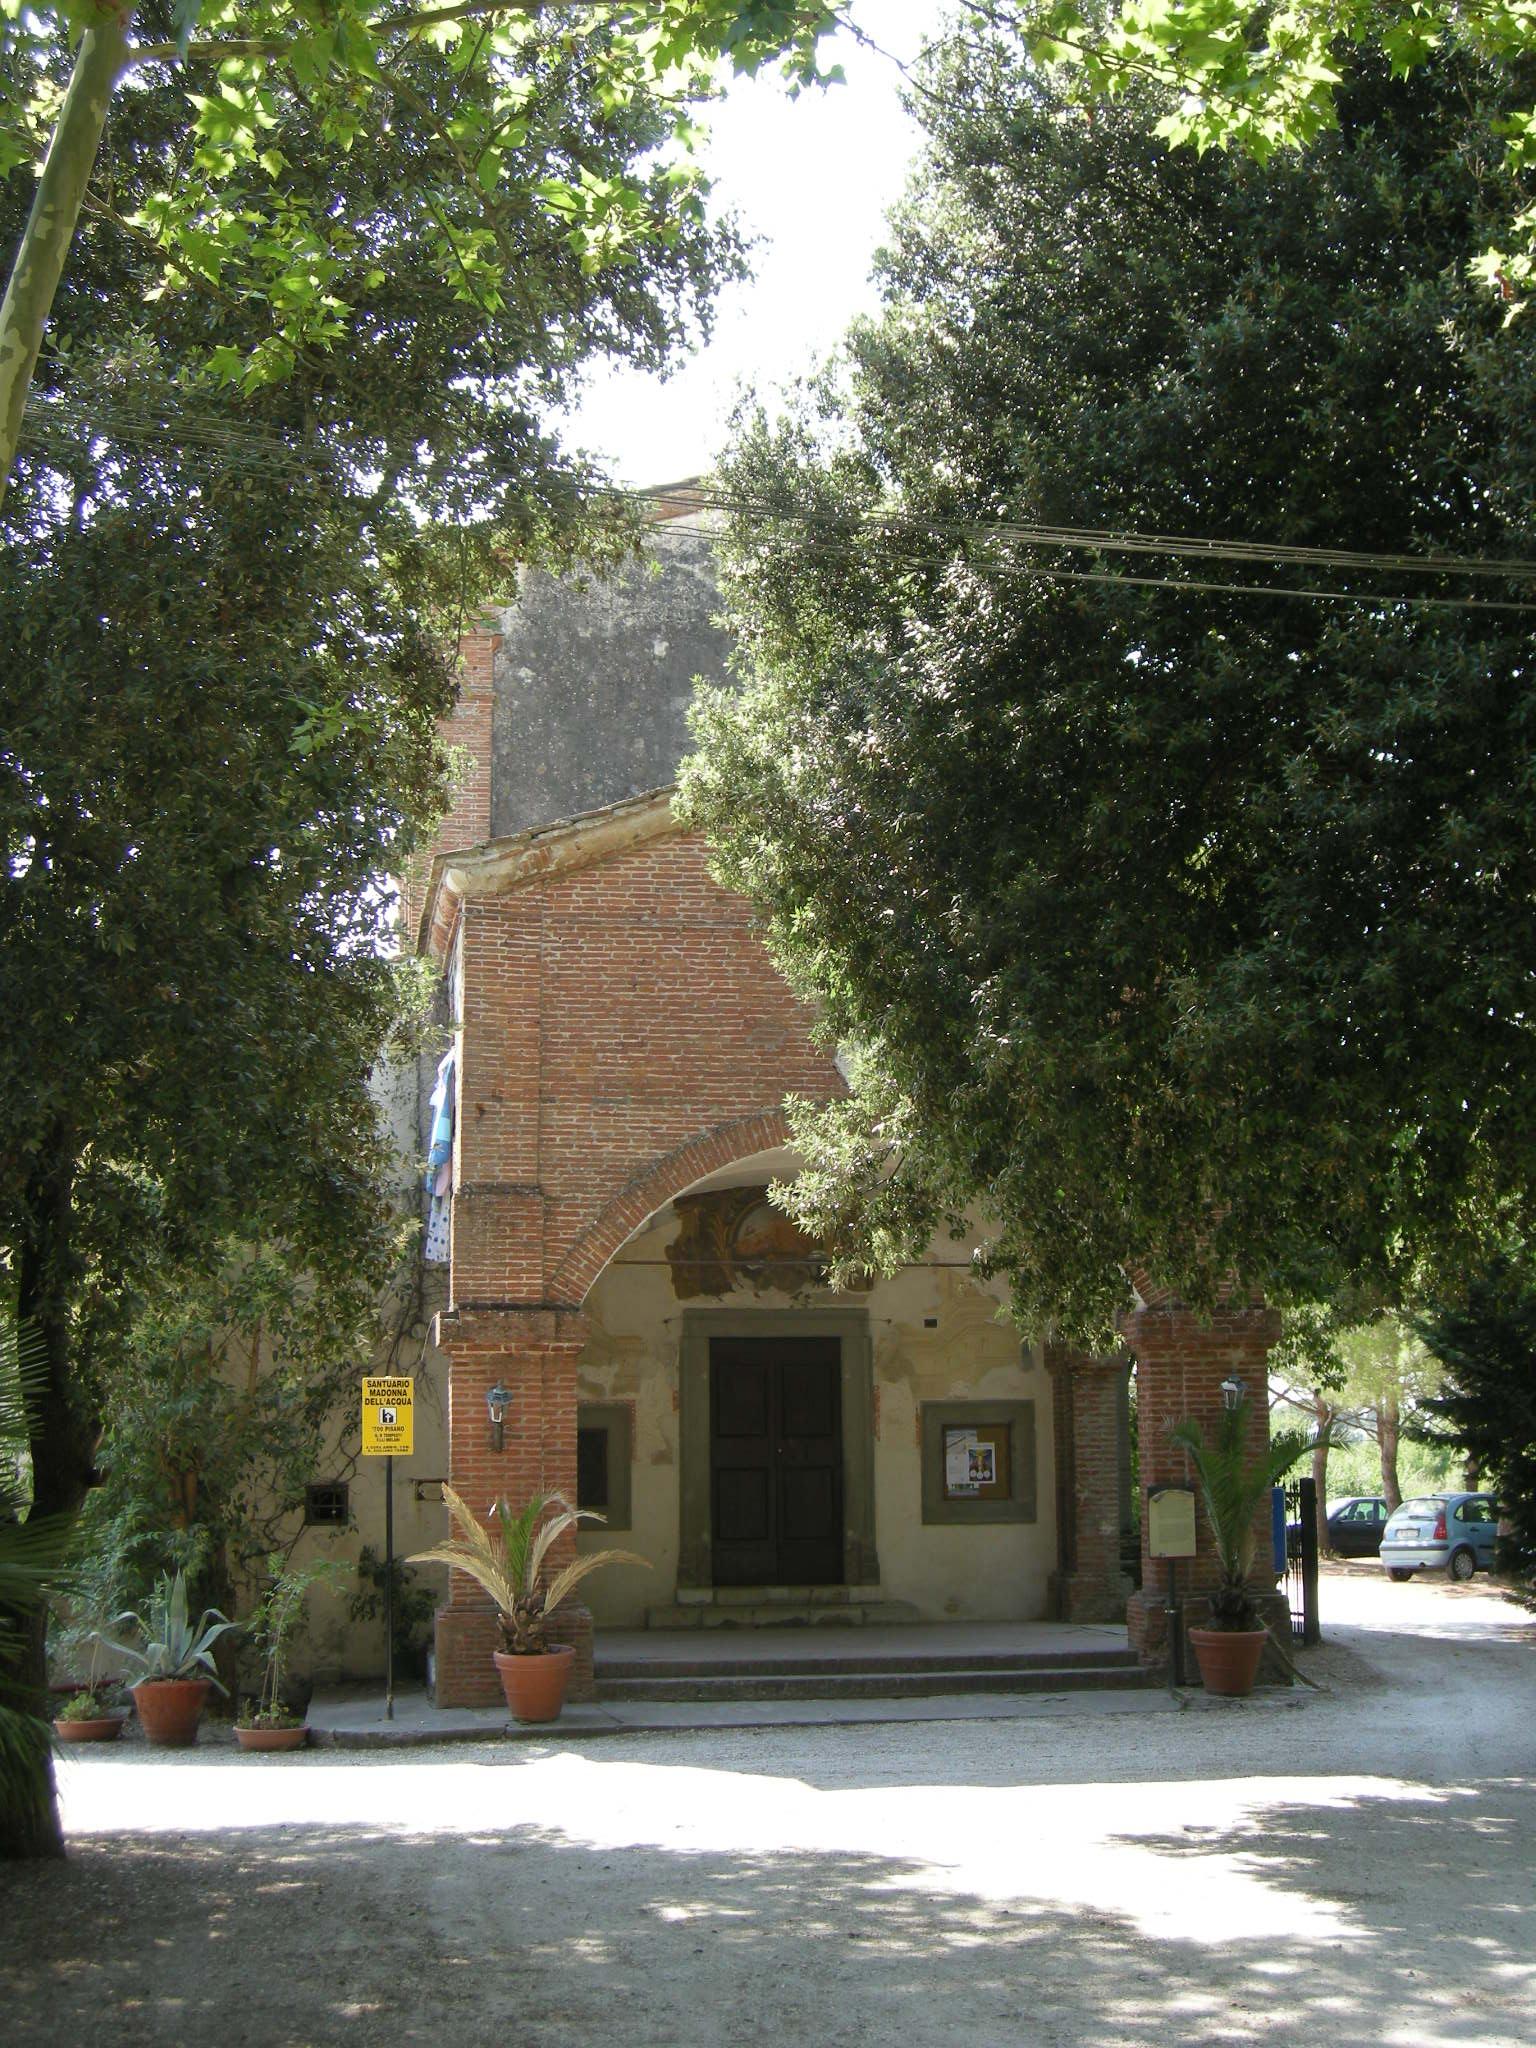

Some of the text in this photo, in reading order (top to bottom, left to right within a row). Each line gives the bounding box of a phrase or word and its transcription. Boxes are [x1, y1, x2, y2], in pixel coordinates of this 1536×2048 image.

[366, 1380, 410, 1388] SANTUARIO
[369, 1389, 408, 1397] MADONNA
[364, 1398, 412, 1406] DELL'ACQUA
